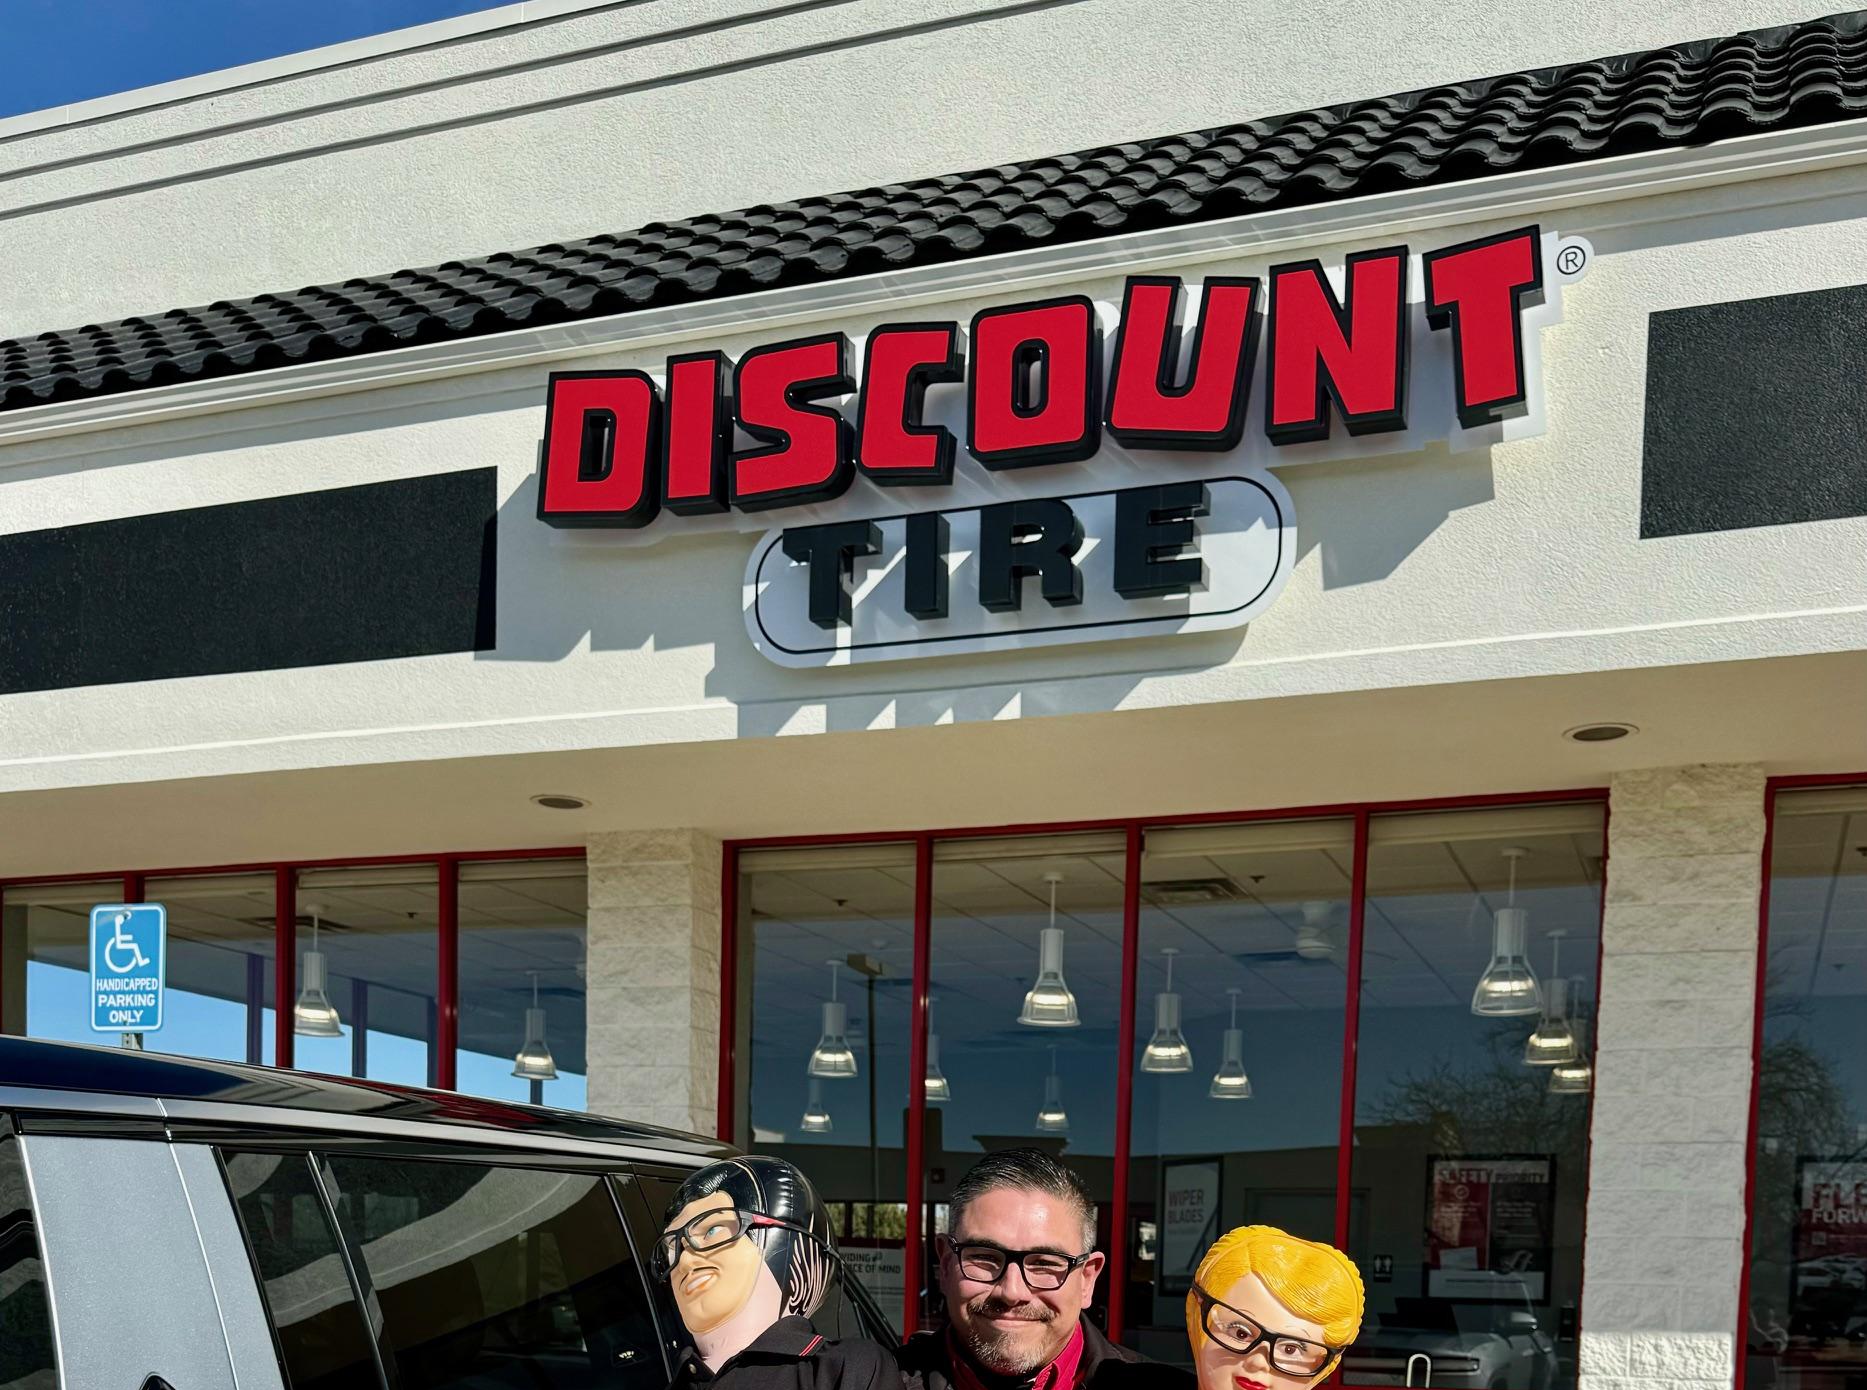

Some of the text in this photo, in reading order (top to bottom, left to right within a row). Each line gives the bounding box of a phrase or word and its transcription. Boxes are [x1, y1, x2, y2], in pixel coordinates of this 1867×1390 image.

[536, 225, 1542, 528] DISCOUNT
[783, 480, 1211, 630] TIRE
[96, 977, 159, 991] HANDICAPPED
[98, 993, 156, 1007] PARKING
[109, 1009, 144, 1023] ONLY
[1168, 1188, 1205, 1206] WIPER
[1168, 1208, 1204, 1224] BLADES
